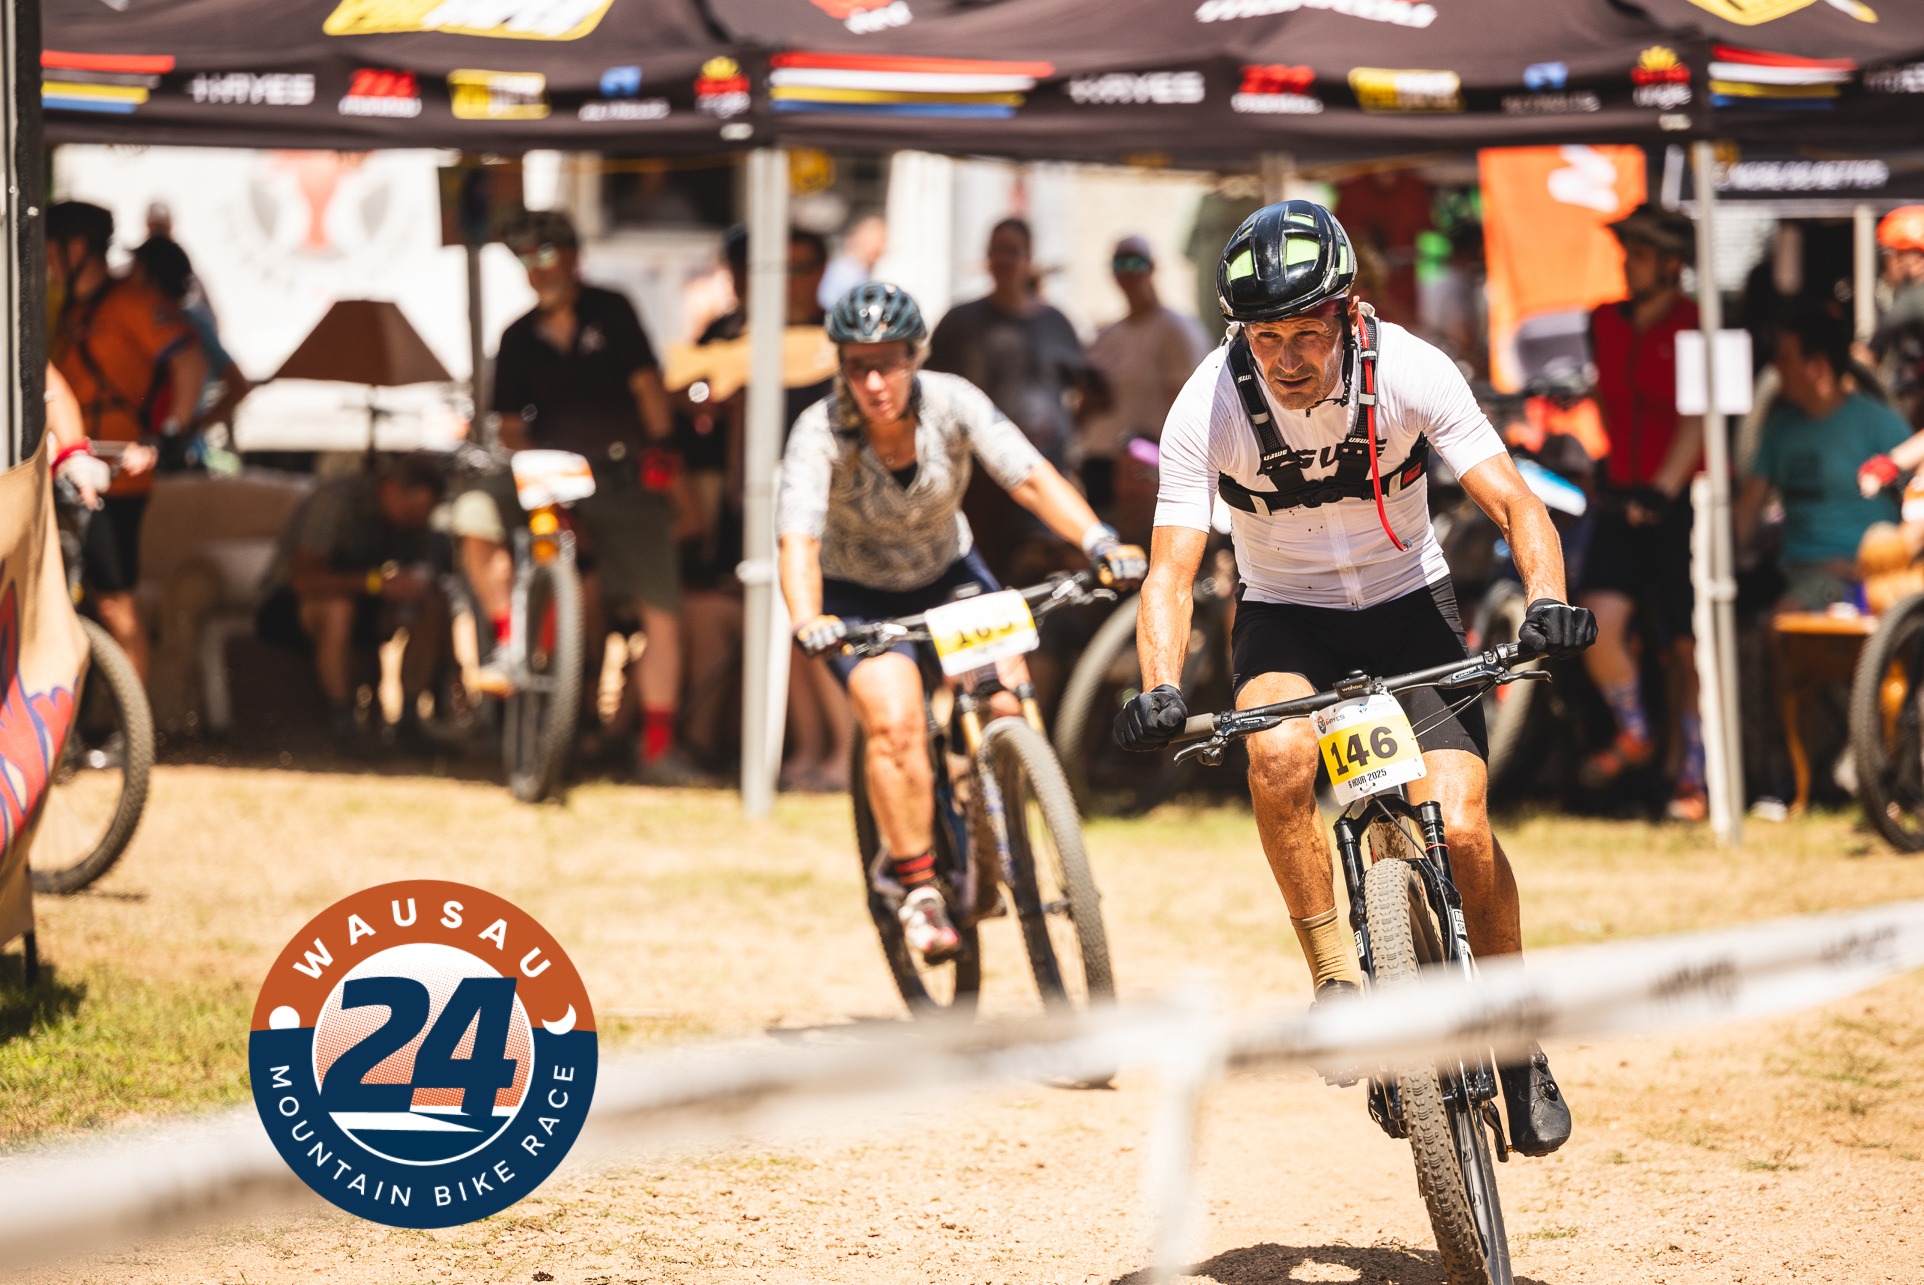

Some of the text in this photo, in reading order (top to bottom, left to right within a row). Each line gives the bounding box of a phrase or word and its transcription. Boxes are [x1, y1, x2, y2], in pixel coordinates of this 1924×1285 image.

[1341, 684, 1363, 692] wahoo
[1330, 726, 1398, 777] 146
[1352, 775, 1367, 788] HOUR
[1368, 768, 1387, 781] 2025
